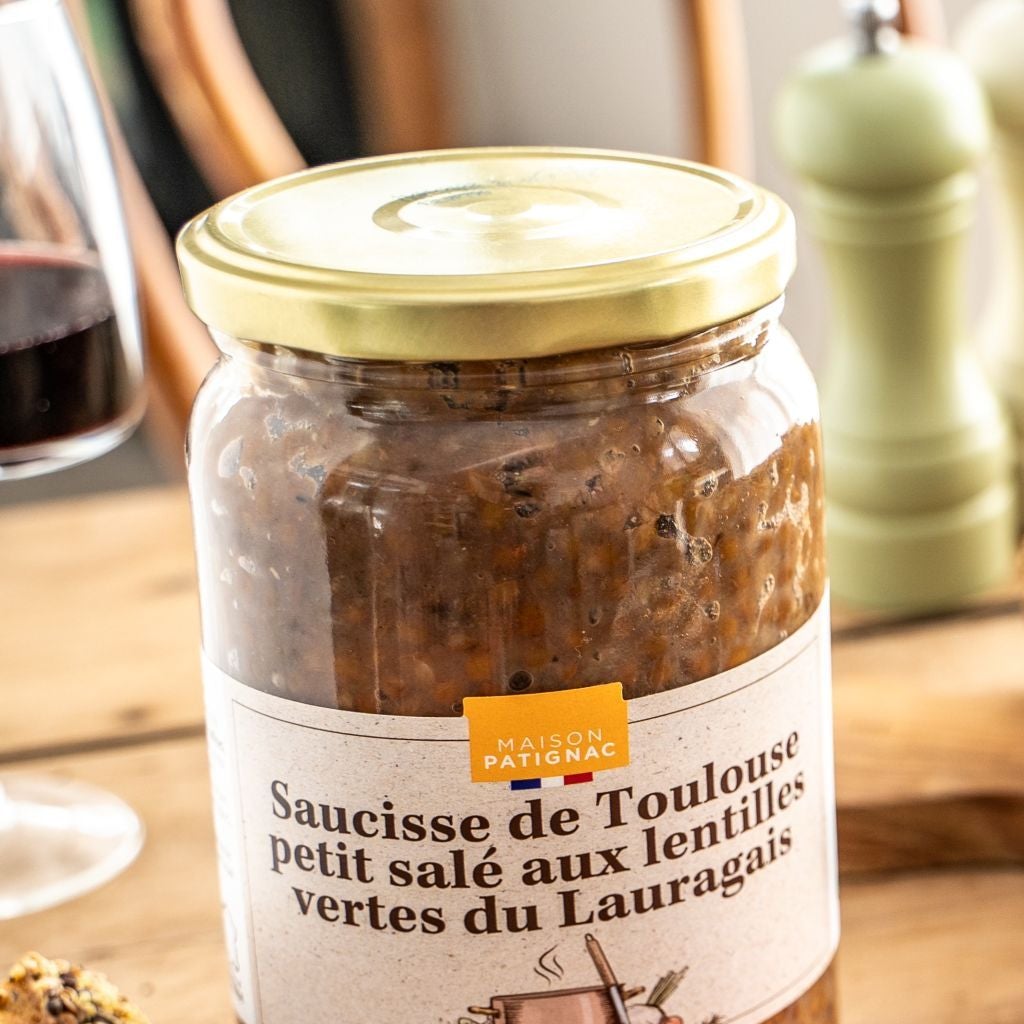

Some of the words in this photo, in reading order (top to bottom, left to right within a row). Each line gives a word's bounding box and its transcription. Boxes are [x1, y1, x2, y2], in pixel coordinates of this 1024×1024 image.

[270, 779, 492, 843] Saucisse
[508, 798, 580, 841] de
[596, 729, 801, 830] Toulouse
[483, 741, 617, 770] PATIGNAC
[497, 727, 602, 753] MAISON
[269, 832, 374, 884] petit
[388, 843, 504, 890] salé
[521, 845, 631, 888] aux
[641, 768, 806, 868] lentilles
[291, 885, 446, 935] vertes
[463, 894, 543, 935] du
[556, 821, 795, 929] Lauragais
